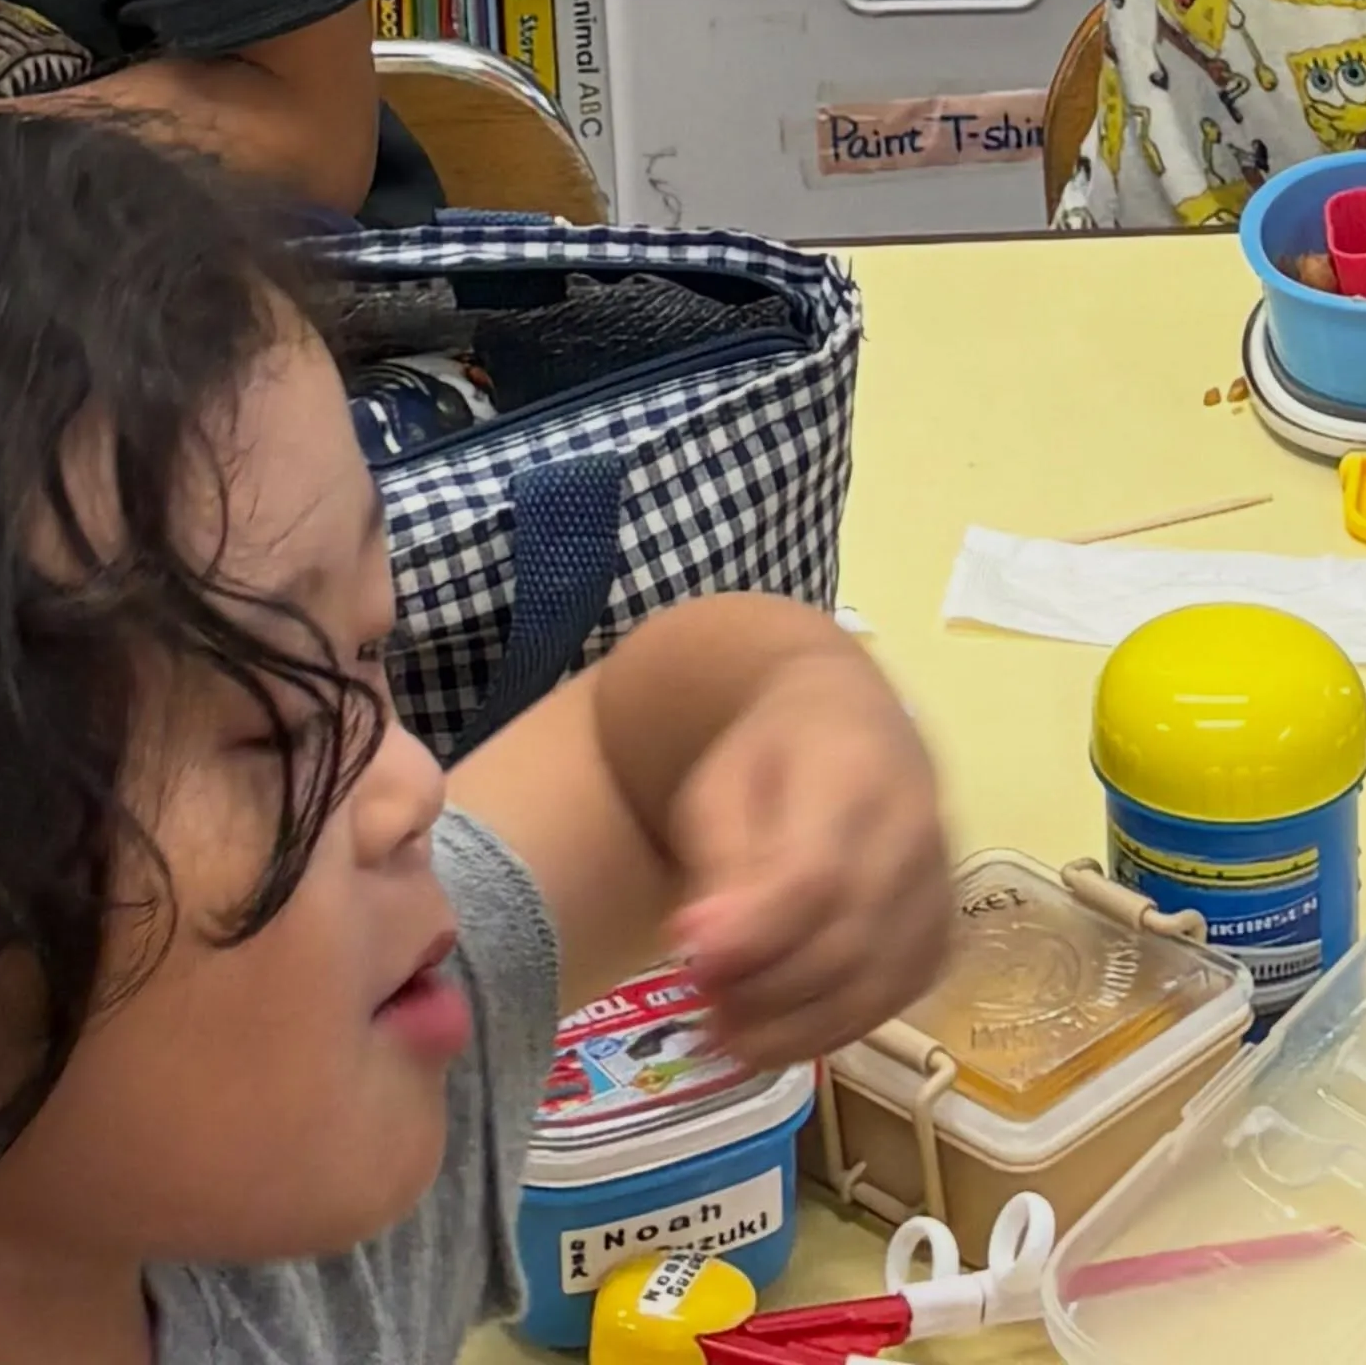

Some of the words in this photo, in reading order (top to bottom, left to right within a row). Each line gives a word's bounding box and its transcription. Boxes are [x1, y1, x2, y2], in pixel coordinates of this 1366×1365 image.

[578, 81, 603, 139] ABC
[829, 112, 925, 162] Paint
[603, 1203, 723, 1252] Noah
[653, 1210, 769, 1254] zuki
